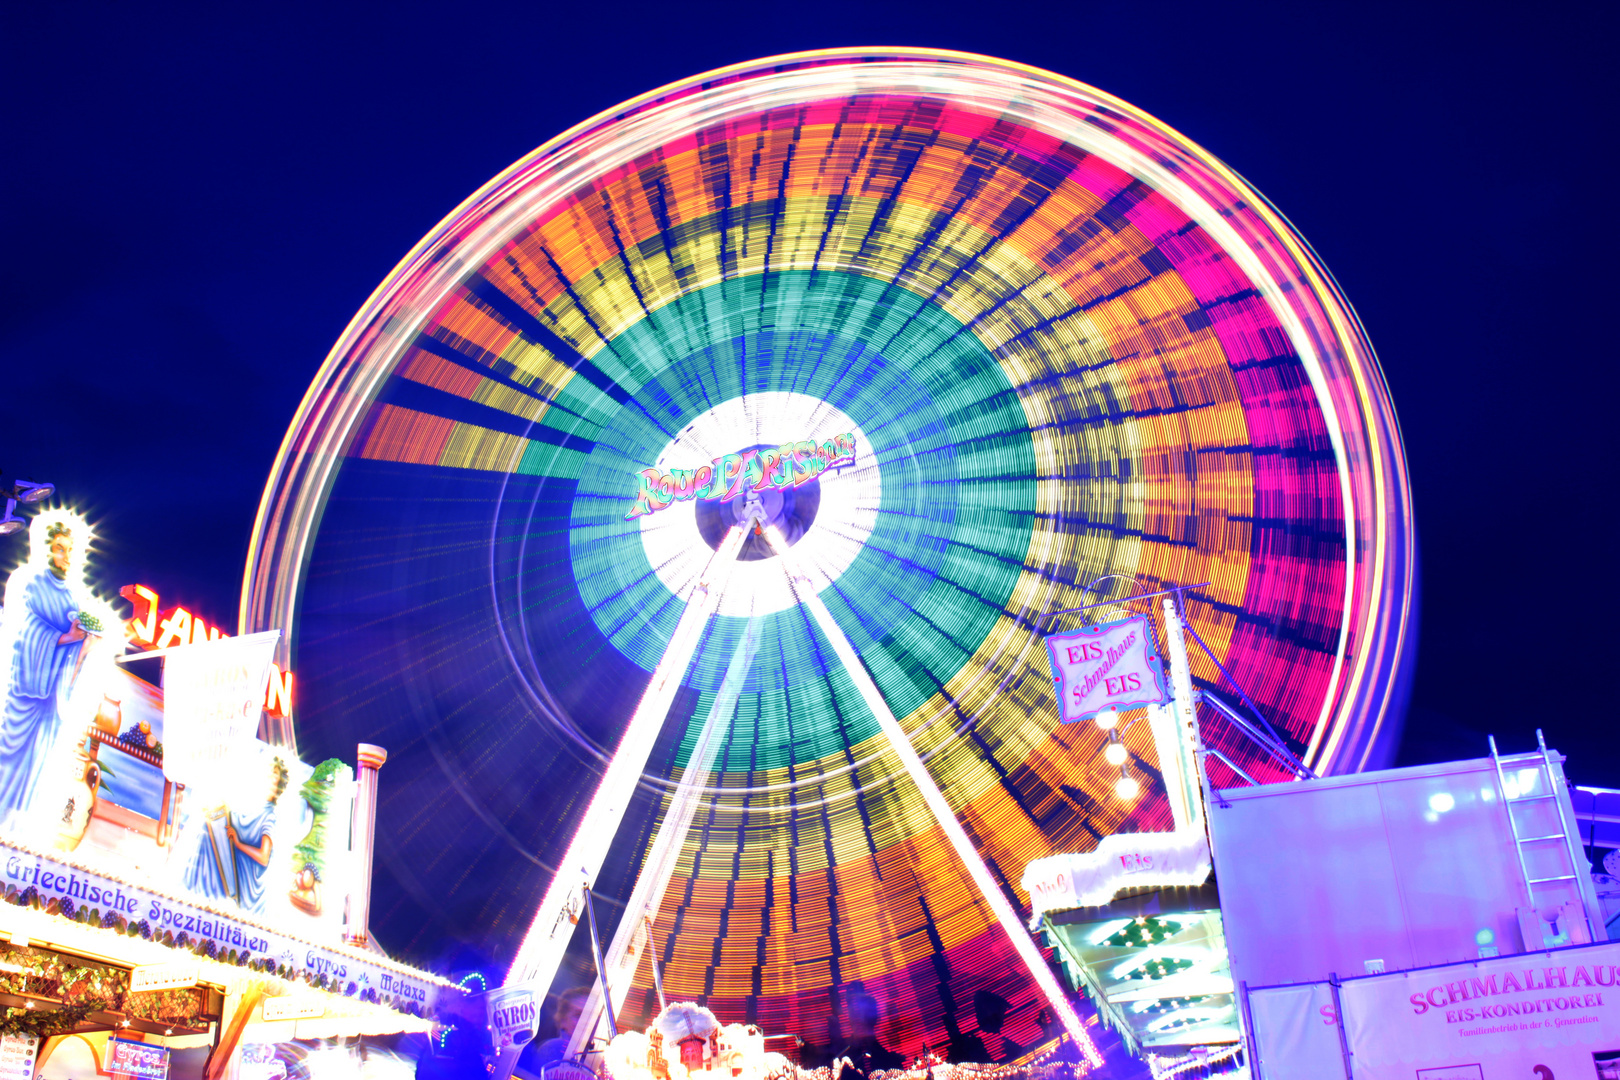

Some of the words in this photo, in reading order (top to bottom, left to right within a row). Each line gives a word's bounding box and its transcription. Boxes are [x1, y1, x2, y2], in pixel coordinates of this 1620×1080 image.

[624, 466, 711, 522] Roue
[1065, 641, 1103, 665] EIS
[1073, 631, 1136, 706] Schmalhaus
[1103, 672, 1142, 696] EIS
[1119, 853, 1154, 876] Eis
[1035, 872, 1068, 898] Nuß
[6, 856, 139, 914] Griechische
[148, 900, 268, 953] Spezialitäten
[306, 950, 347, 978] Gyros
[380, 973, 426, 1002] Metaxa
[1409, 965, 1620, 1015] SCHMALHAU
[493, 1001, 536, 1029] GYROS
[1446, 993, 1605, 1024] EIS-KONDITOREI
[1458, 1023, 1519, 1037] Familienbetrieb
[1520, 1022, 1528, 1031] in
[1530, 1020, 1543, 1030] der
[1544, 1019, 1553, 1028] 6.
[1554, 1015, 1599, 1029] Generation
[116, 1043, 161, 1065] Gyros
